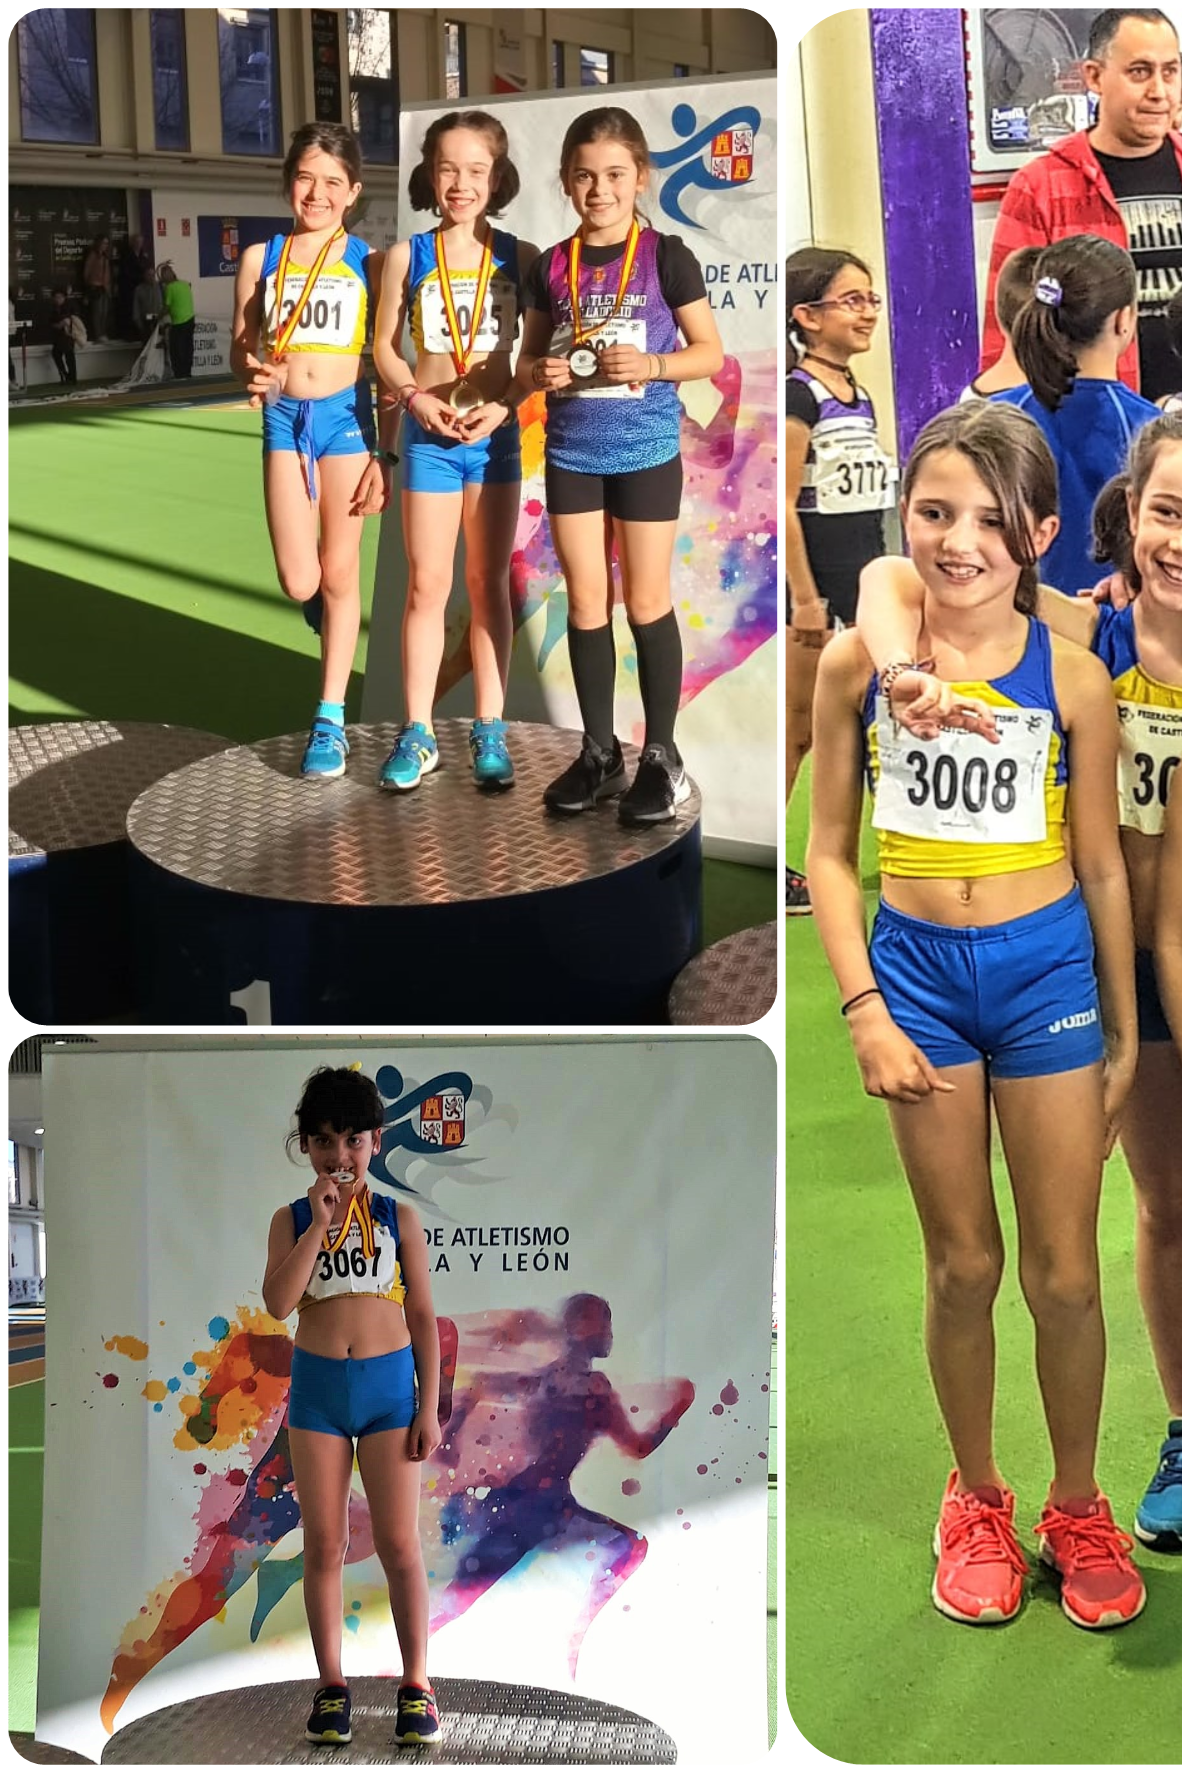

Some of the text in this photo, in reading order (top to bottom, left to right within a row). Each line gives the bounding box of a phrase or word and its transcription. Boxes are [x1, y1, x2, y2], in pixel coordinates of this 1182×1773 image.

[219, 262, 239, 273] Cast
[705, 265, 730, 283] DE
[587, 295, 647, 306] ATLETSMO
[708, 290, 768, 309] LA Y
[837, 460, 888, 496] 3772
[1149, 725, 1159, 735] DE
[907, 750, 1018, 813] 3008
[1133, 752, 1182, 808] 30
[230, 979, 271, 1025] 1
[451, 1226, 570, 1247] ATLETISMO
[317, 1247, 381, 1281] 3067
[470, 1253, 483, 1272] Y
[502, 1248, 569, 1272] LEÓN
